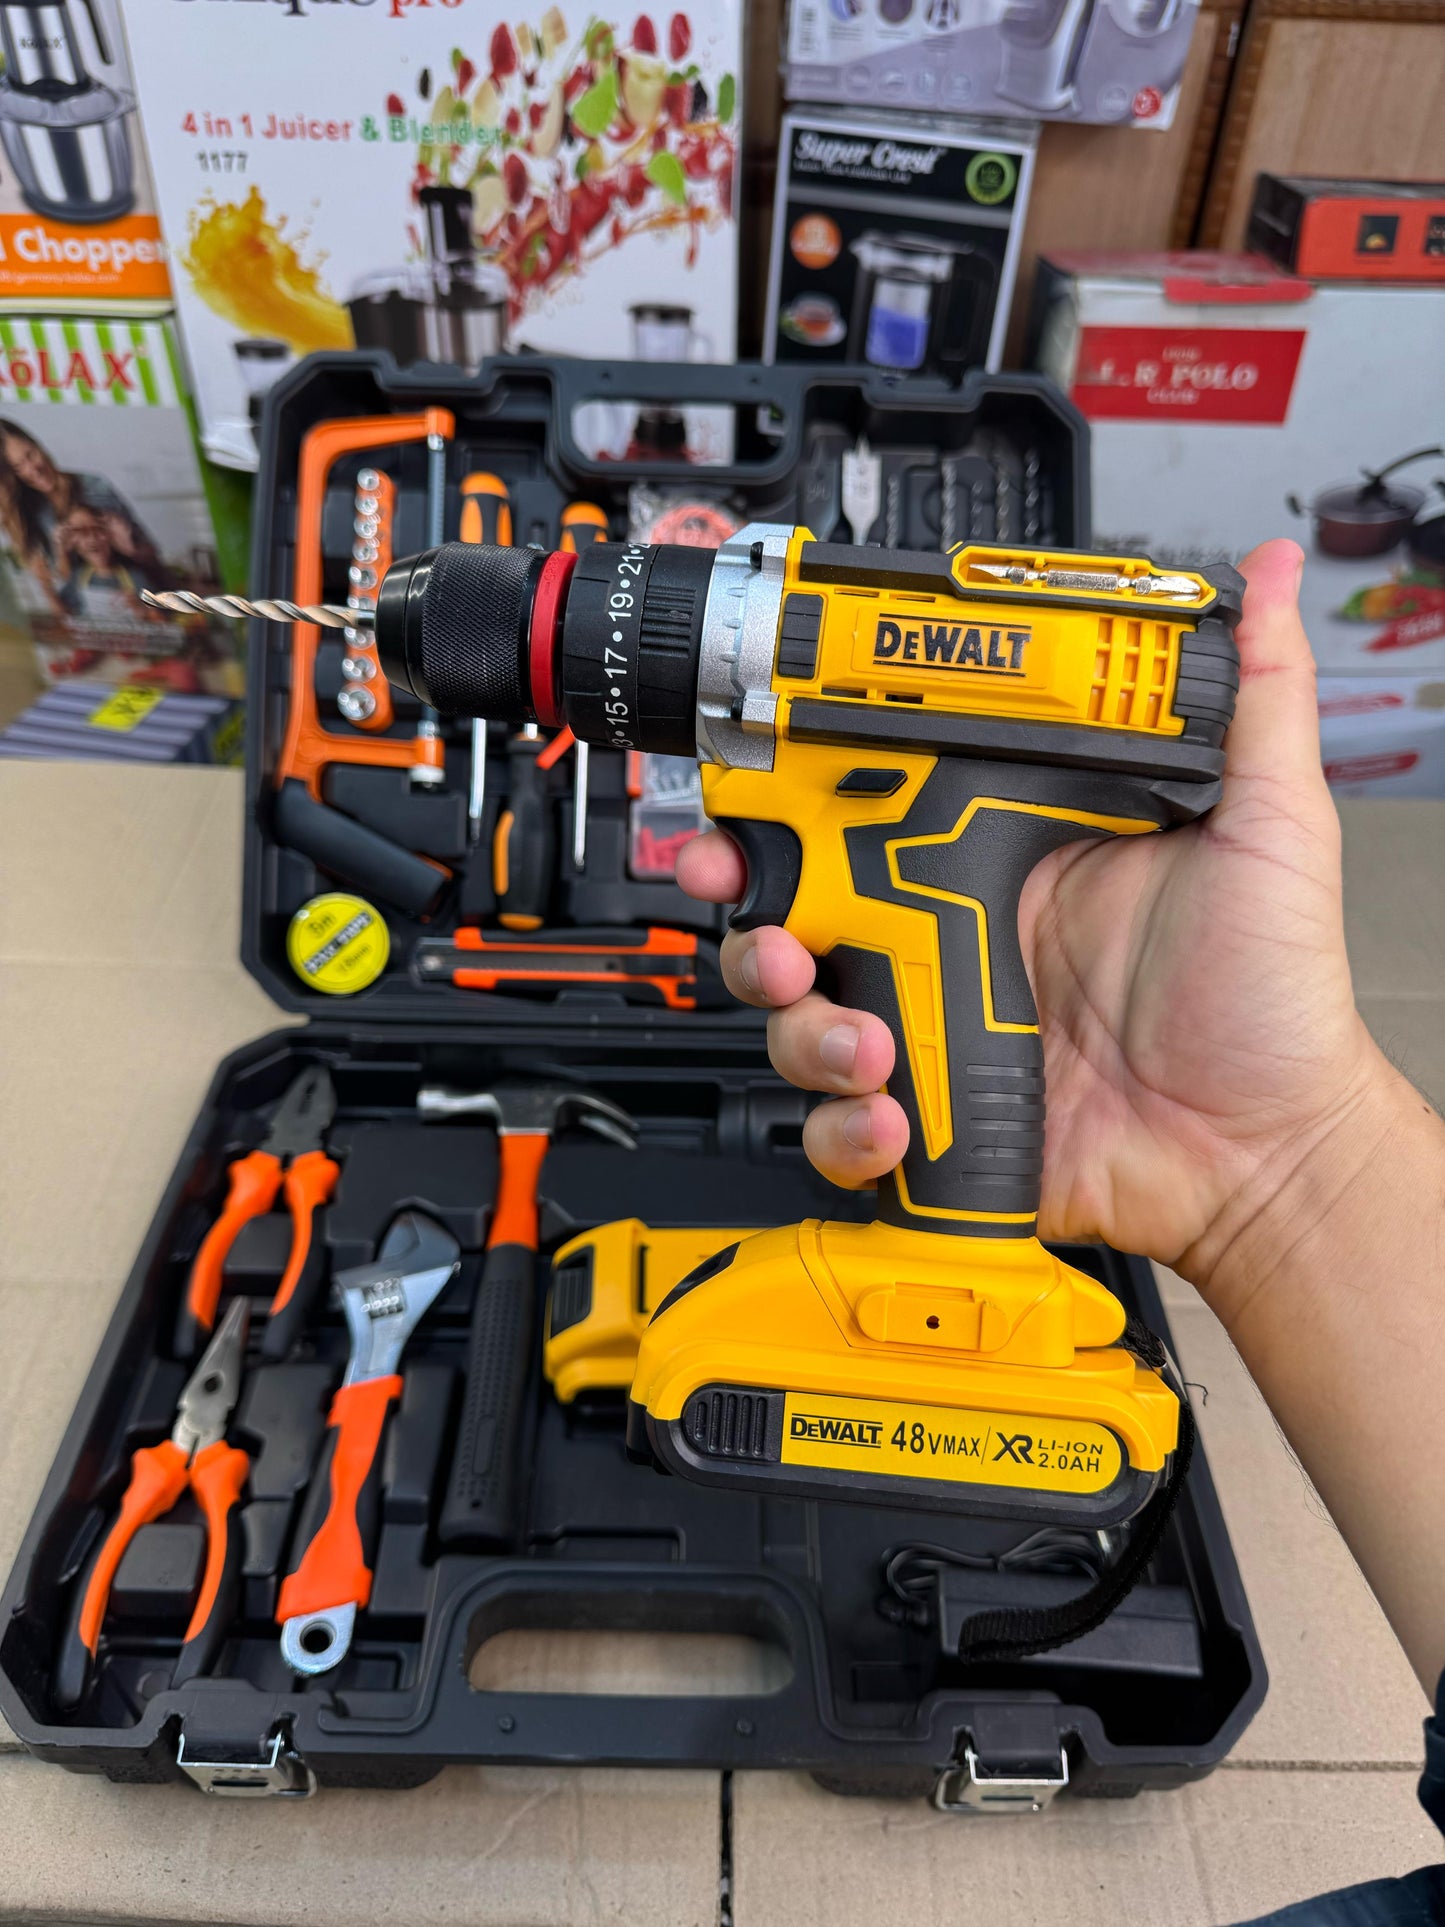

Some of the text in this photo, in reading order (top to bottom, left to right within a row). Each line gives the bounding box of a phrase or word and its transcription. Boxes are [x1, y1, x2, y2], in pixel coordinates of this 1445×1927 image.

[182, 111, 197, 136] 4
[205, 112, 232, 138] in
[240, 113, 253, 138] 1
[262, 114, 352, 141] Juicer
[359, 115, 381, 142] &
[198, 150, 249, 173] 1177
[617, 554, 646, 576] 21
[608, 592, 635, 622] 19
[604, 647, 629, 679] 17
[605, 701, 630, 726] 15
[992, 1431, 1035, 1465] XR
[1038, 1438, 1104, 1455] LI-ION
[1038, 1452, 1100, 1473] 2.0AH
